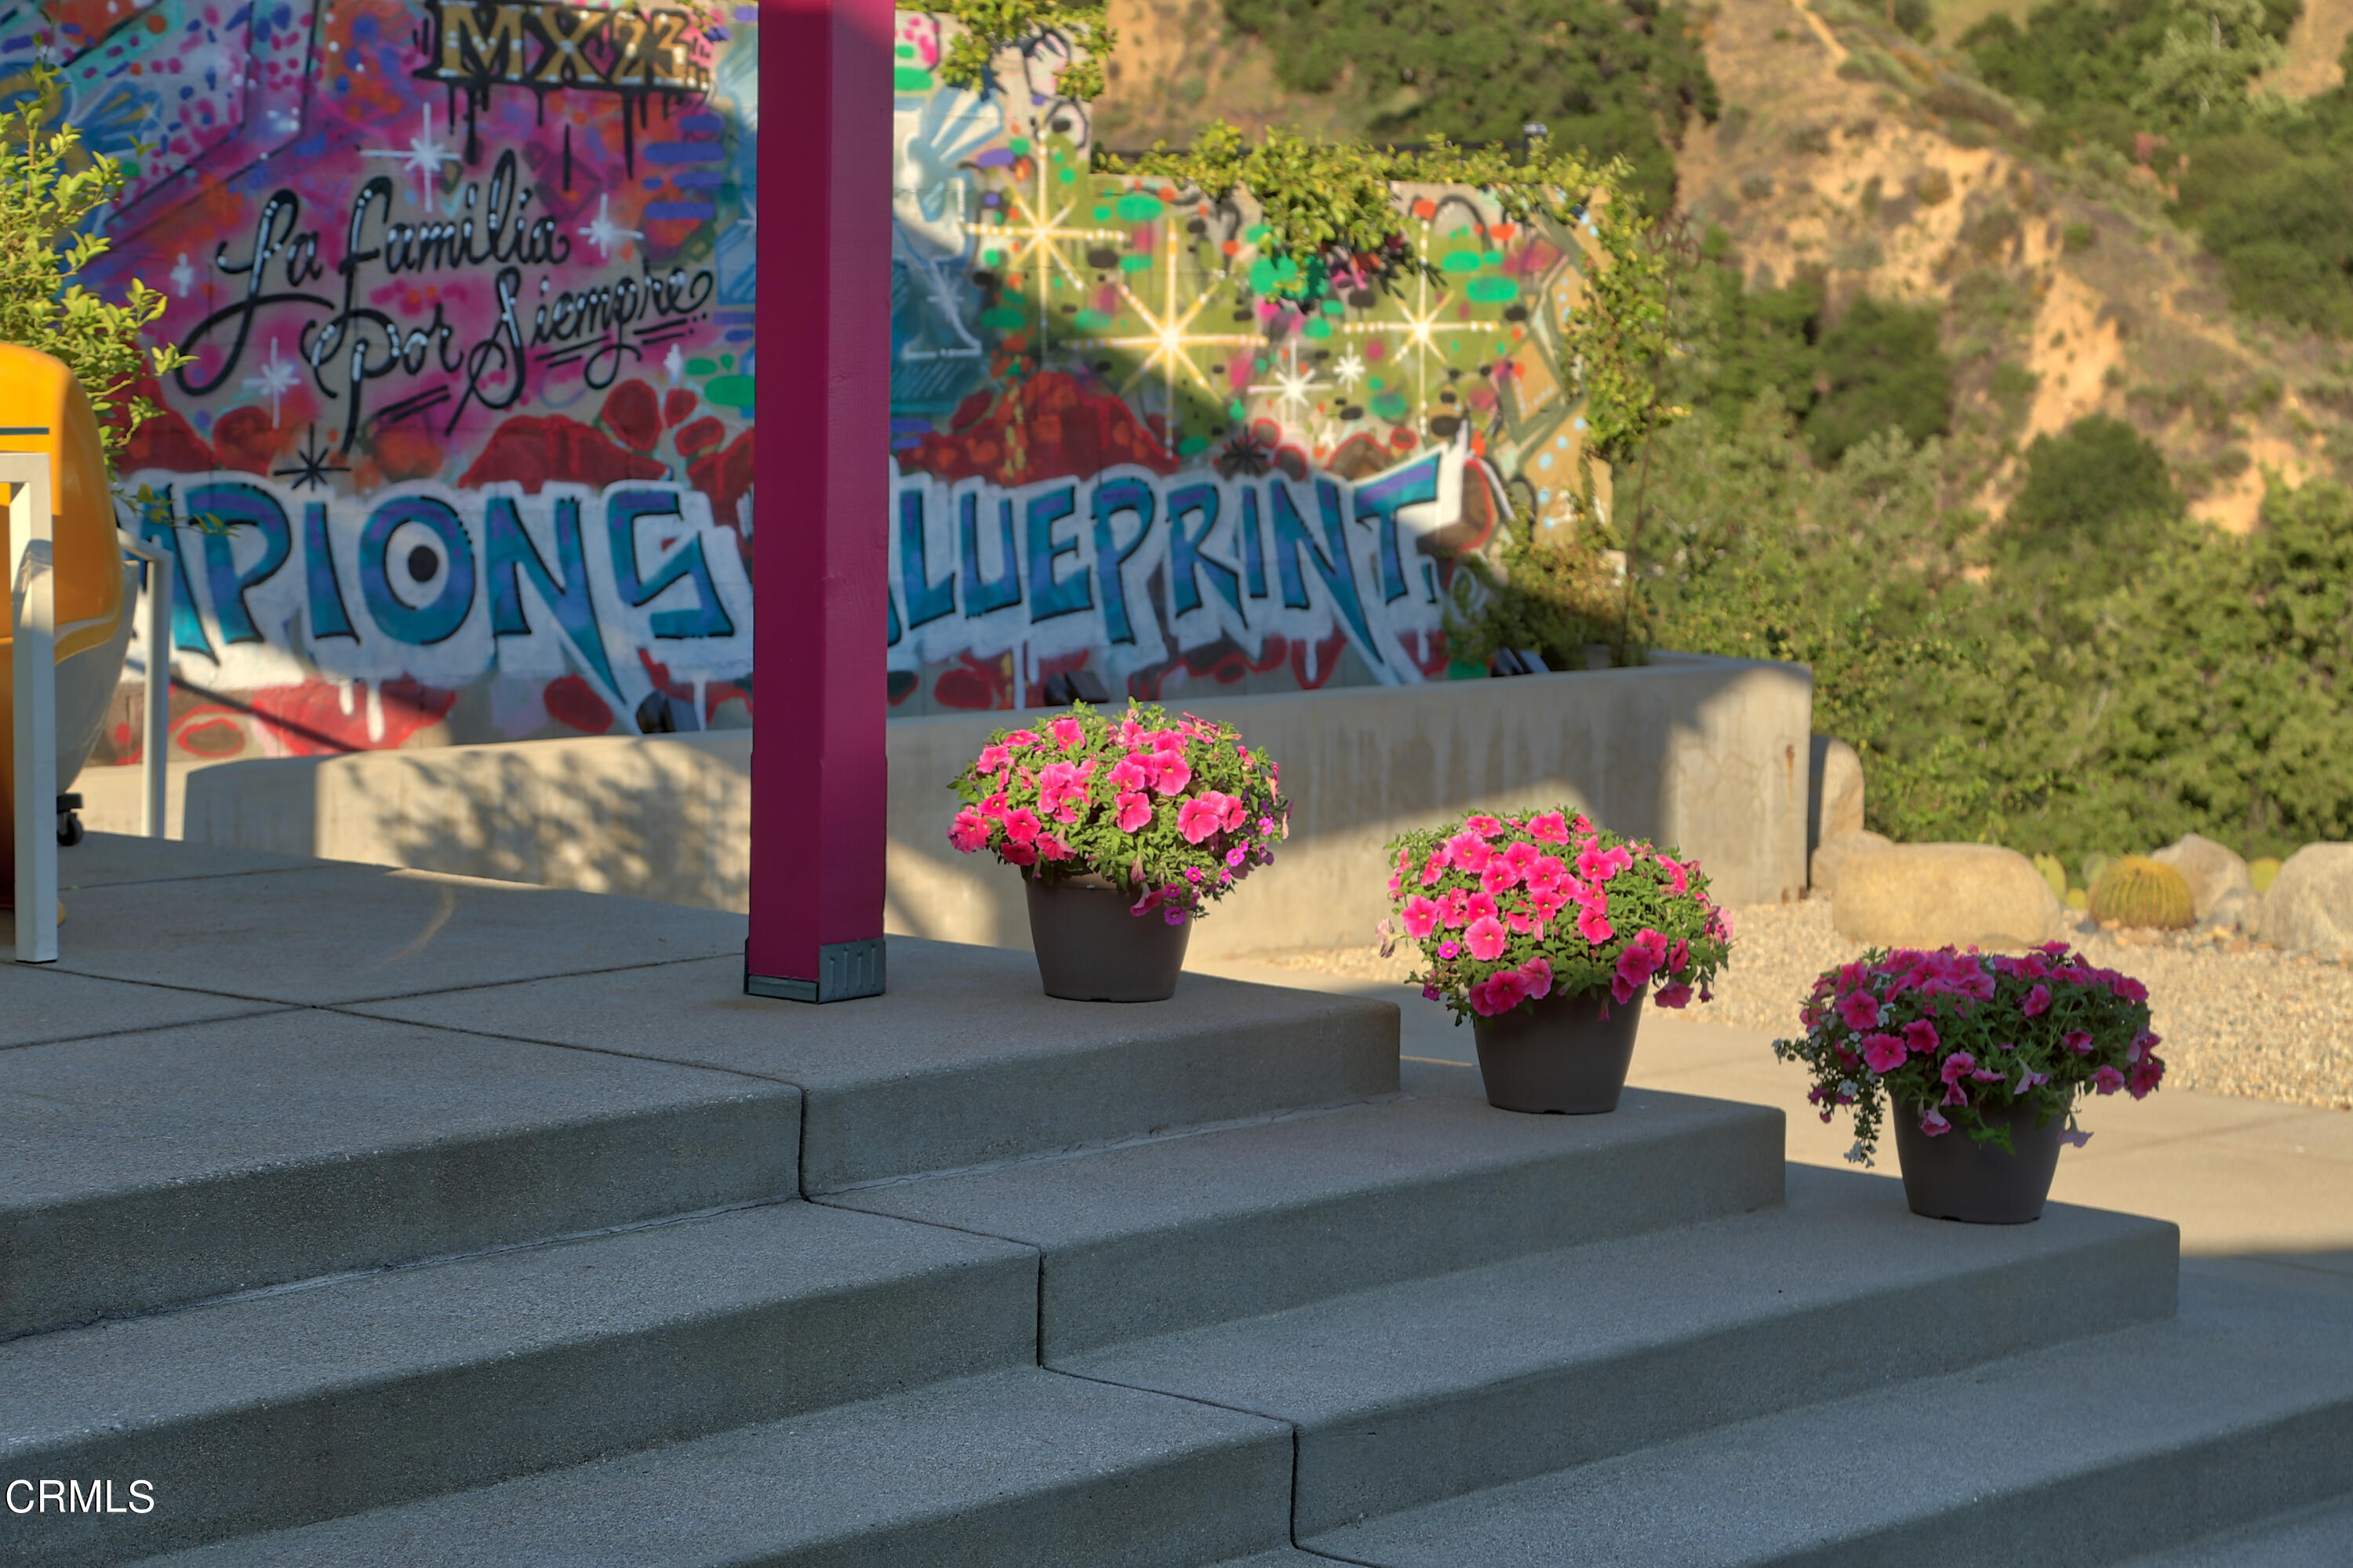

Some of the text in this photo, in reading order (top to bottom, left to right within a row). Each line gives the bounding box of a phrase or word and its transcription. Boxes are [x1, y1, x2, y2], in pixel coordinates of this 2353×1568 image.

[174, 189, 334, 396] La
[446, 257, 713, 437] Siempre
[888, 450, 1442, 665] LUEPRINT
